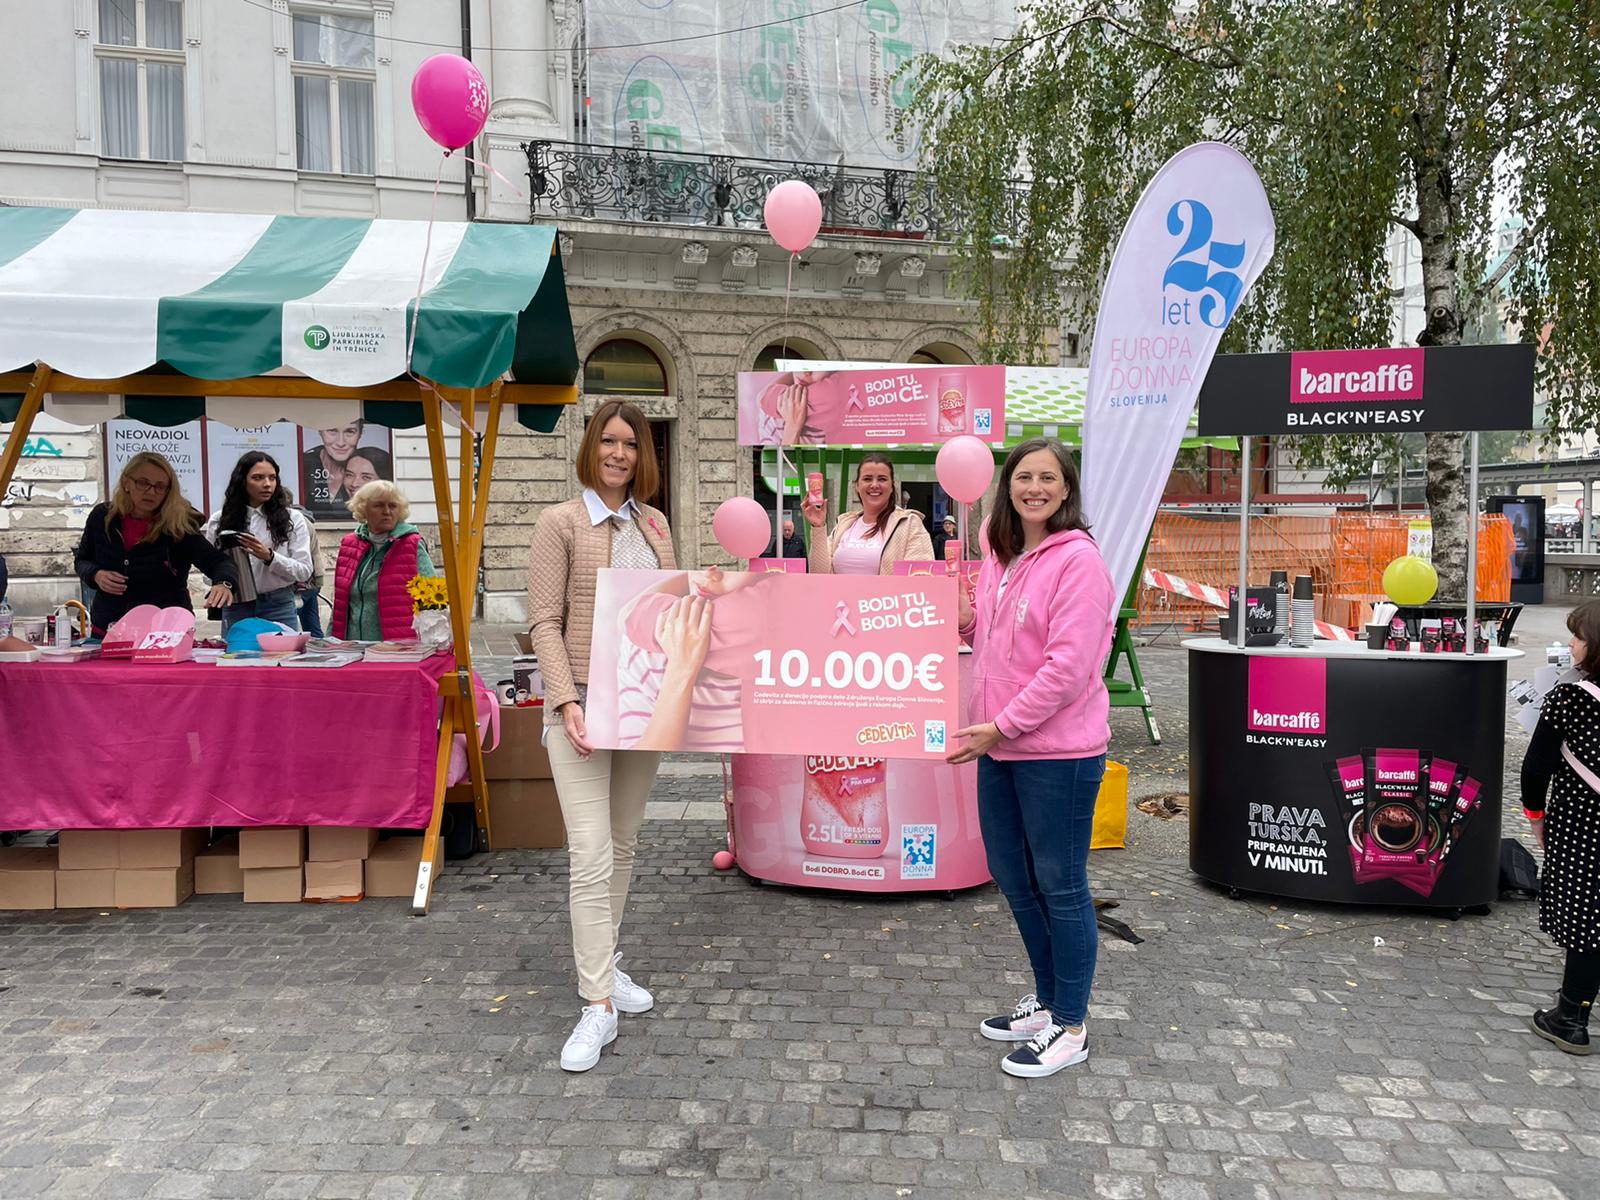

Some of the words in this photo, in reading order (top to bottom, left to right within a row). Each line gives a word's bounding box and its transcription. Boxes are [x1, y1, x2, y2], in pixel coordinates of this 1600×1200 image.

[1162, 199, 1246, 329] 25
[1162, 296, 1191, 325] let
[1111, 335, 1193, 363] EUROPA
[864, 377, 895, 393] BODI
[897, 373, 918, 386] TU.
[1109, 364, 1194, 392] DONNA
[1300, 364, 1413, 395] barcaffé
[867, 392, 897, 408] BODI
[899, 384, 929, 403] CE.
[1110, 393, 1168, 408] SLOVENIJA
[1287, 409, 1425, 426] BLACK'N'EASY
[115, 430, 190, 440] NEOVADIOL
[116, 443, 148, 453] NEGA
[151, 441, 180, 453] KOŽE
[116, 454, 124, 463] V
[858, 595, 900, 614] BODI
[901, 591, 930, 607] TU.
[860, 614, 903, 632] BODI
[904, 605, 945, 628] CE.
[753, 649, 945, 692] 10.000€
[1253, 708, 1320, 729] barcaffé
[858, 723, 915, 743] CEDEVITA
[1246, 734, 1327, 747] BLACK'N'EASY
[1378, 769, 1416, 780] barcaffé
[1248, 802, 1326, 828] PRAVA
[903, 825, 935, 834] EUROPA
[1248, 821, 1328, 847] TURŠKA,
[1247, 839, 1328, 858] PRIPRAVLJENA
[805, 865, 820, 873] Bodi
[821, 866, 851, 875] DOBRO.
[851, 869, 867, 877] Bodi
[902, 865, 934, 873] DONNA
[1247, 851, 1261, 867] V
[1264, 854, 1328, 876] MINUTI.
